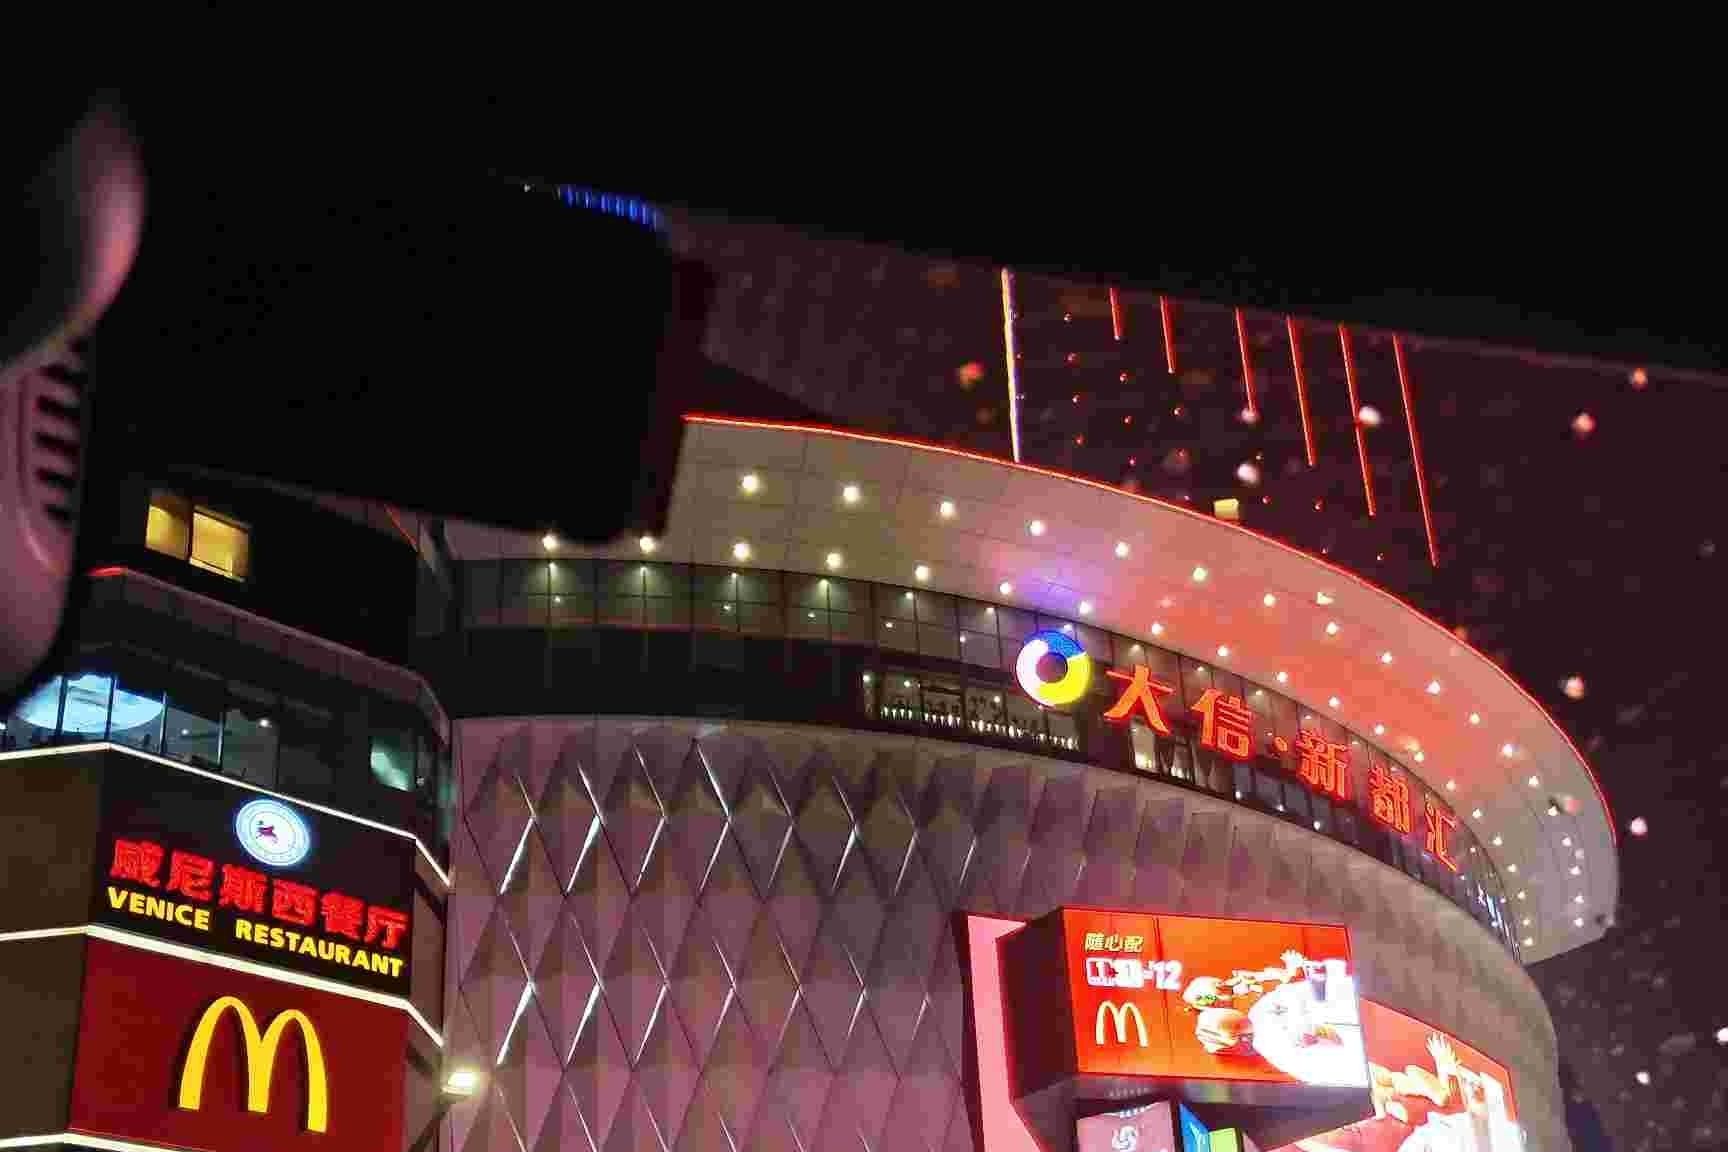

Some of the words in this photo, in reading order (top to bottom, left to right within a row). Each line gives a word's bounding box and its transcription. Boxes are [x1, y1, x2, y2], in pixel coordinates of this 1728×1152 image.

[107, 886, 210, 931] VENICE
[234, 919, 404, 977] RESTAURANT
[110, 838, 409, 949] 威尼斯西餐厅
